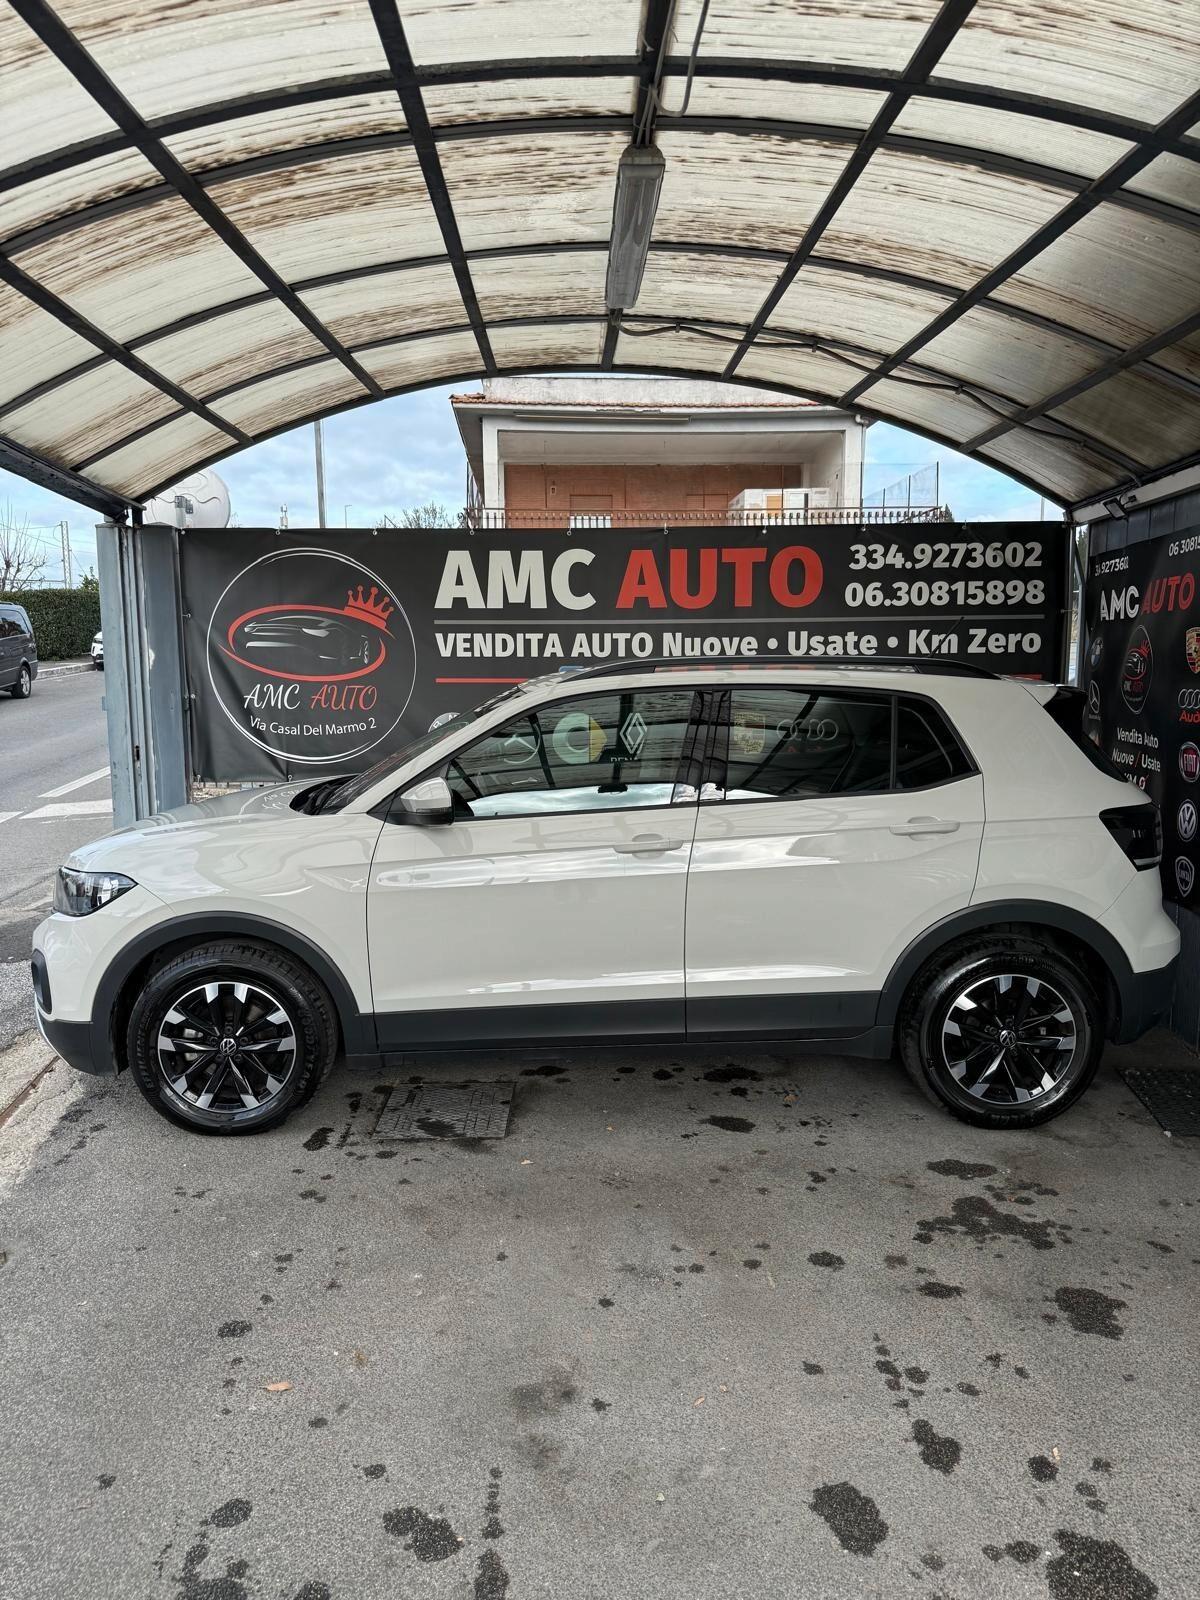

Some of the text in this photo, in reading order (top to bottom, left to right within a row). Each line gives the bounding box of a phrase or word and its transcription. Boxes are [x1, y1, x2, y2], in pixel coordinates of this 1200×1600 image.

[849, 542, 1042, 570] 334.9273602
[435, 546, 824, 610] AMC AUTO
[845, 580, 1045, 608] 06.30815898
[1100, 572, 1195, 621] AMC AUTO
[435, 628, 1042, 658] VENDITA AUTO Nuove Usate Km Zero
[243, 683, 377, 711] AMC AUTO
[250, 715, 377, 736] Via Casal Del Marmo 2
[1117, 727, 1159, 748] Vendita Auto
[1112, 748, 1135, 765] Nuove
[1141, 753, 1160, 772] Usate
[1183, 754, 1197, 773] FIAT
